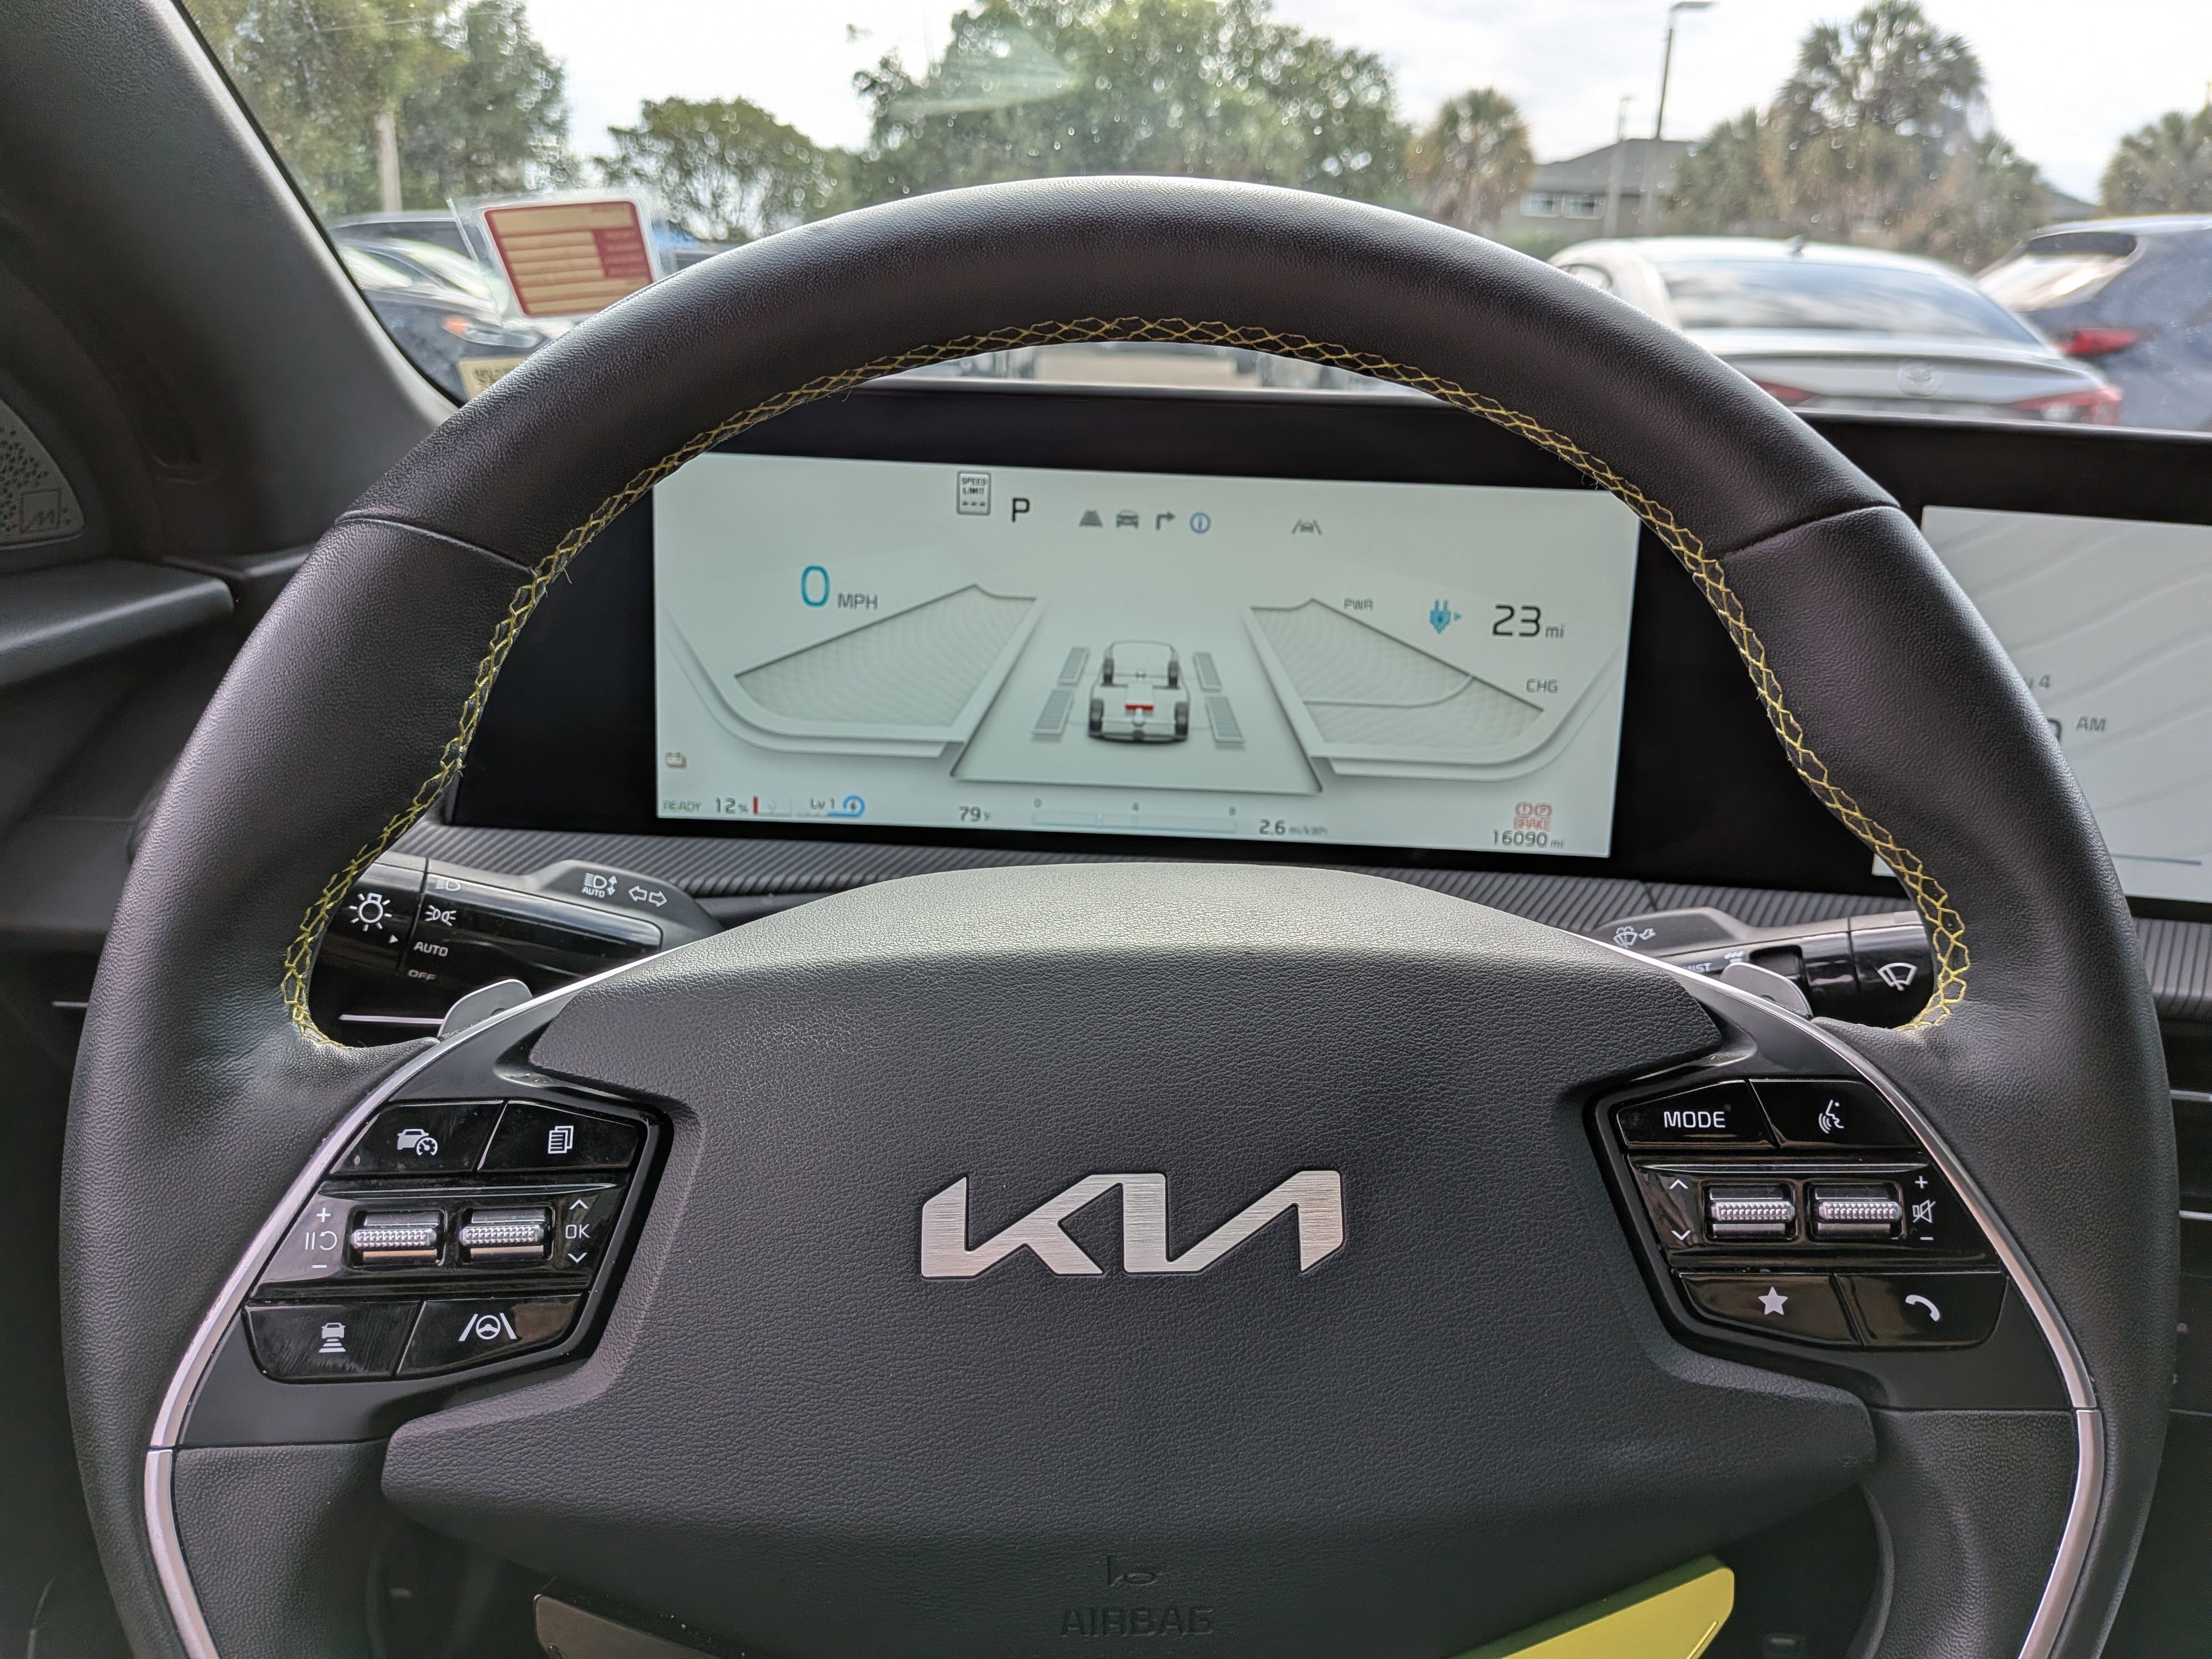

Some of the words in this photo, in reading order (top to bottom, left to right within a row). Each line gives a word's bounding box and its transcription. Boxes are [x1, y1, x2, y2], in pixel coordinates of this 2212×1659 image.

[1011, 497, 1030, 522] P
[801, 565, 830, 608] 0
[837, 592, 878, 610] MPH
[1343, 597, 1374, 611] PWR
[1493, 604, 1541, 637] 23
[1545, 623, 1565, 639] mi
[1525, 678, 1558, 694] CHG
[2076, 716, 2106, 731] AM
[663, 800, 701, 813] READY
[1259, 818, 1286, 836] 2.6
[1494, 830, 1548, 848] 16090
[1551, 839, 1564, 848] mi
[581, 886, 606, 899] AUTO
[413, 941, 448, 957] AUTO
[408, 969, 436, 980] OFF
[1664, 1110, 1726, 1129] MODE
[565, 1224, 591, 1240] OK
[1061, 1605, 1214, 1637] AIRBAG
